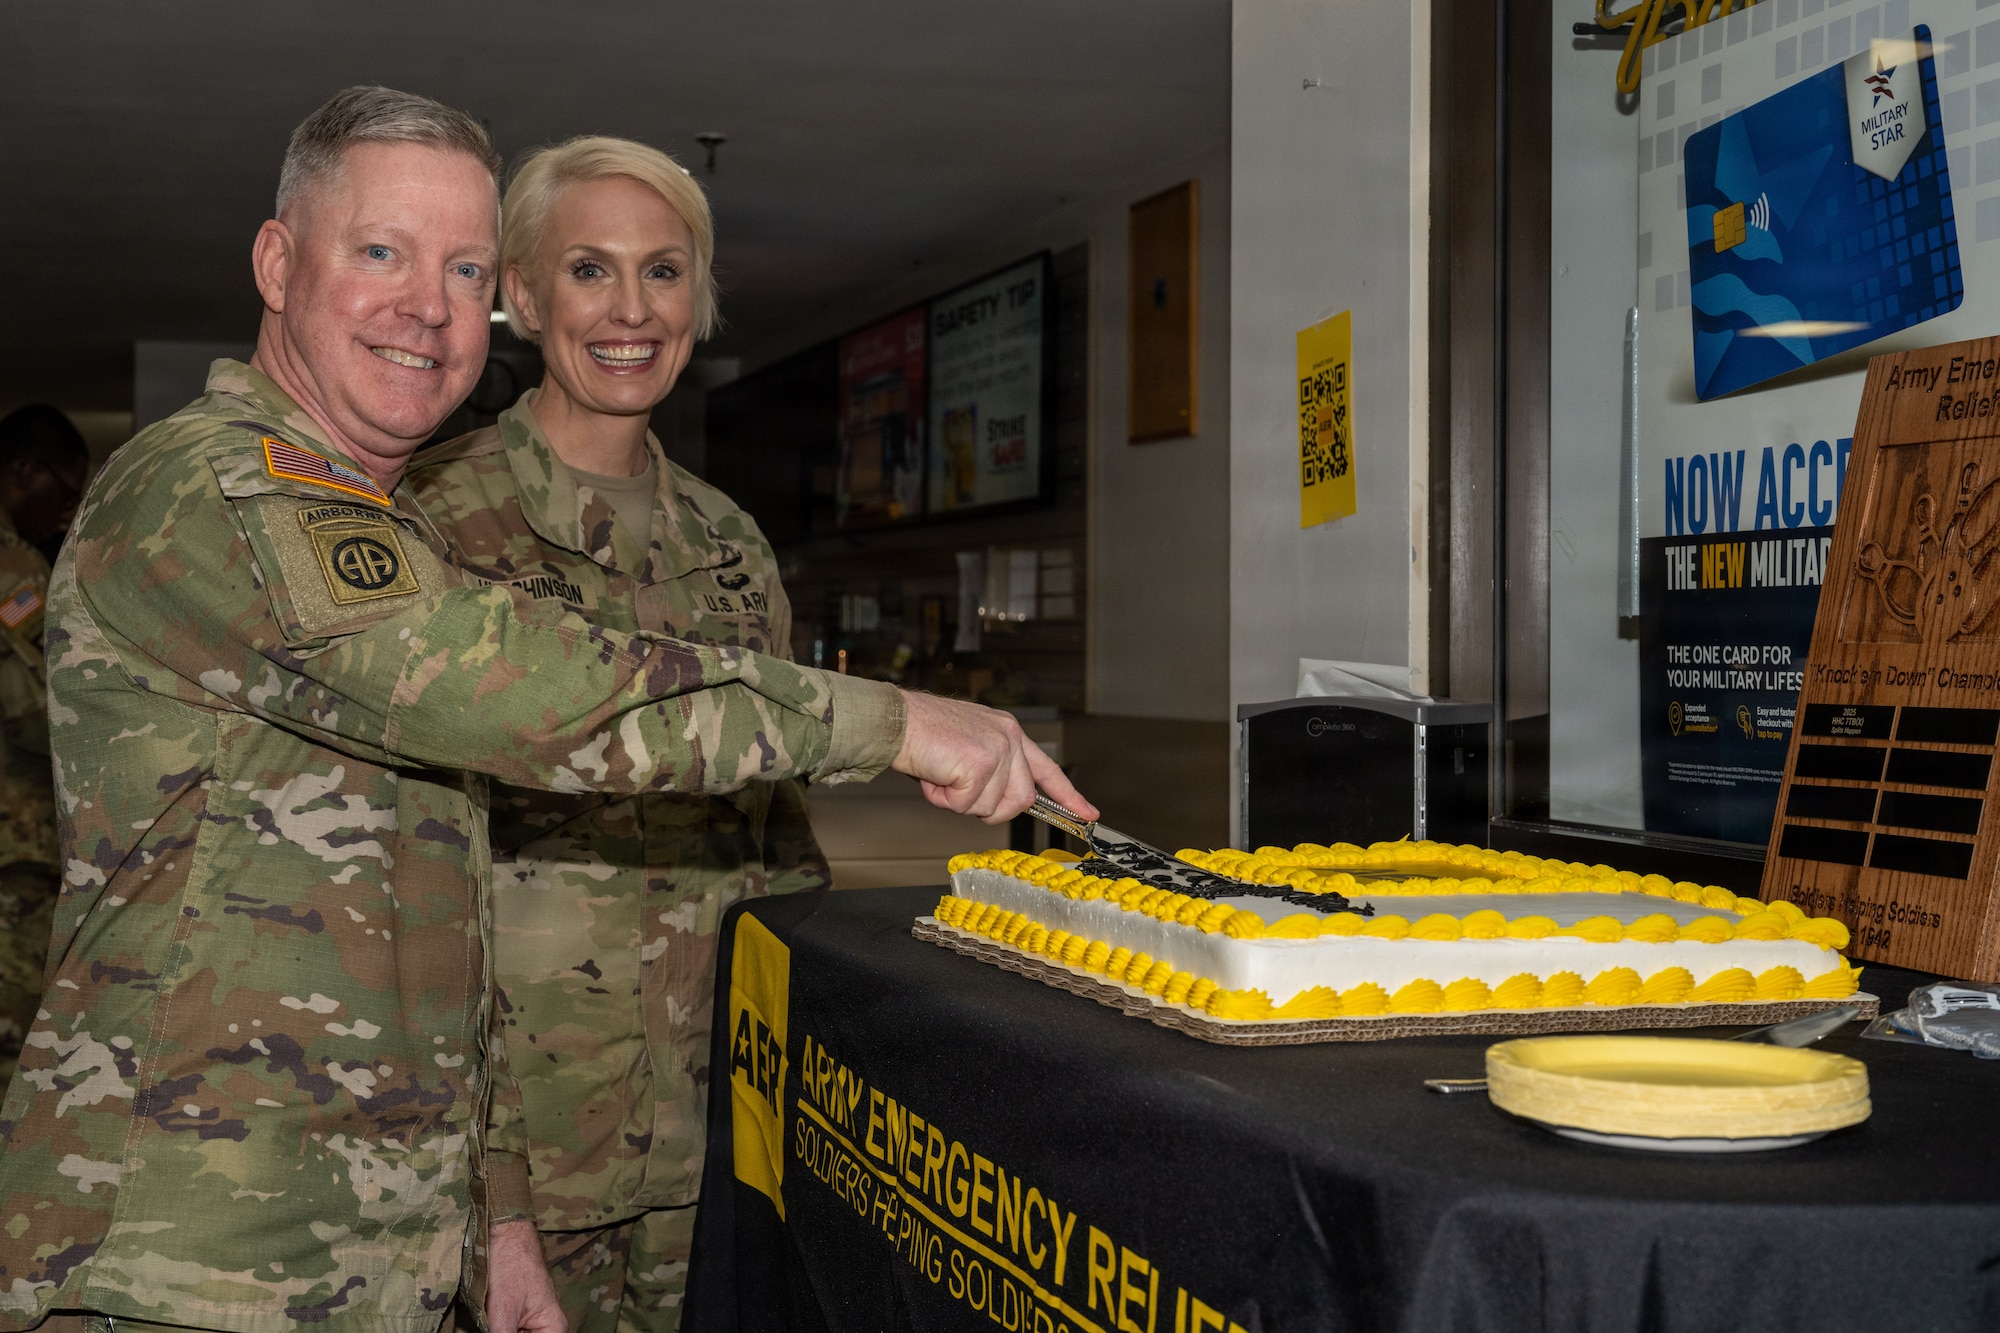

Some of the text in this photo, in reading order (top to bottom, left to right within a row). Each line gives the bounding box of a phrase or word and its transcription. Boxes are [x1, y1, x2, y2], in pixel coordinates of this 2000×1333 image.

[1861, 101, 1909, 135] MILITARY
[1871, 123, 1905, 151] STAR
[937, 291, 1001, 337] SAFETY
[1007, 278, 1035, 310] TIP
[1885, 366, 1943, 393] Army
[1665, 450, 1746, 537] NOW
[307, 507, 386, 522] AIRBORNE
[1665, 545, 1697, 590] THE
[1702, 542, 1746, 590] NEW
[703, 593, 740, 613] U.S.
[1667, 645, 1792, 665] THE ONE CARD FOR
[1667, 669, 1701, 688] YOUR
[1703, 670, 1763, 690] MILITARY
[1685, 703, 1706, 713] Expanded
[1685, 714, 1710, 723] acceptance
[1757, 706, 1769, 717] Easy
[1769, 707, 1779, 717] and
[1843, 707, 1857, 716] 2025
[1757, 718, 1781, 728] checkout
[1831, 716, 1845, 725] HHC
[1757, 729, 1766, 739] tap
[1773, 731, 1783, 741] pay
[1791, 885, 1942, 928] Soldiers Helping Soldiers
[1861, 926, 1891, 949] 1942
[796, 1118, 871, 1217] SOLDIERS
[802, 1034, 864, 1139] ARMY
[865, 1086, 1077, 1287] EMERGENCY
